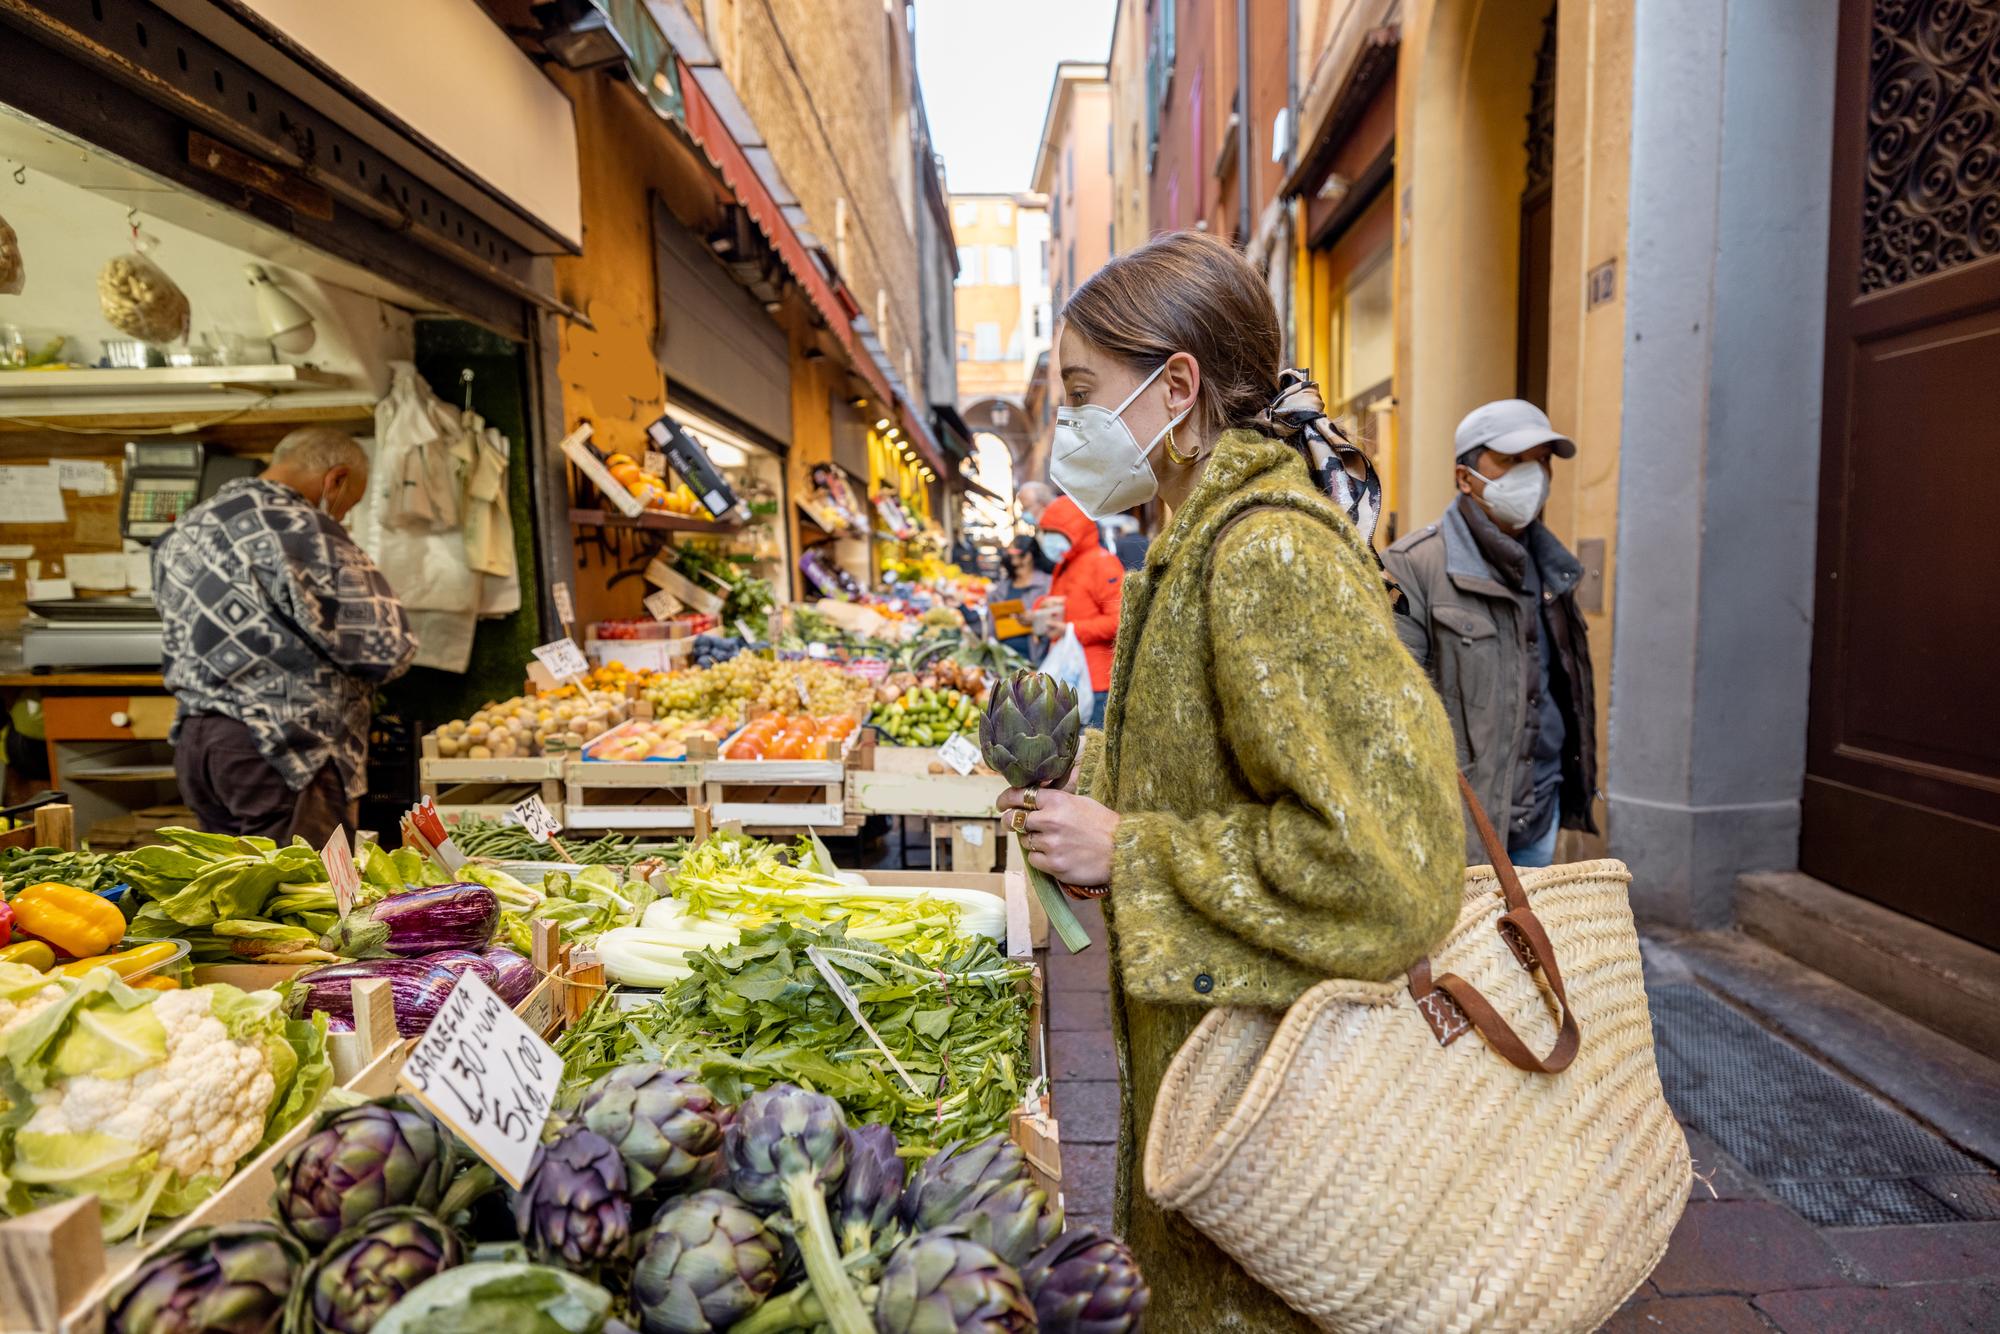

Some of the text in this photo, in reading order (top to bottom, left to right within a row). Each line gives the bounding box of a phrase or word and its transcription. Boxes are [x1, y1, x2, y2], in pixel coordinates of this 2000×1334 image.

[1592, 269, 1614, 304] 12
[408, 986, 474, 1092] SARDEGNA
[472, 996, 503, 1050] L'UNO
